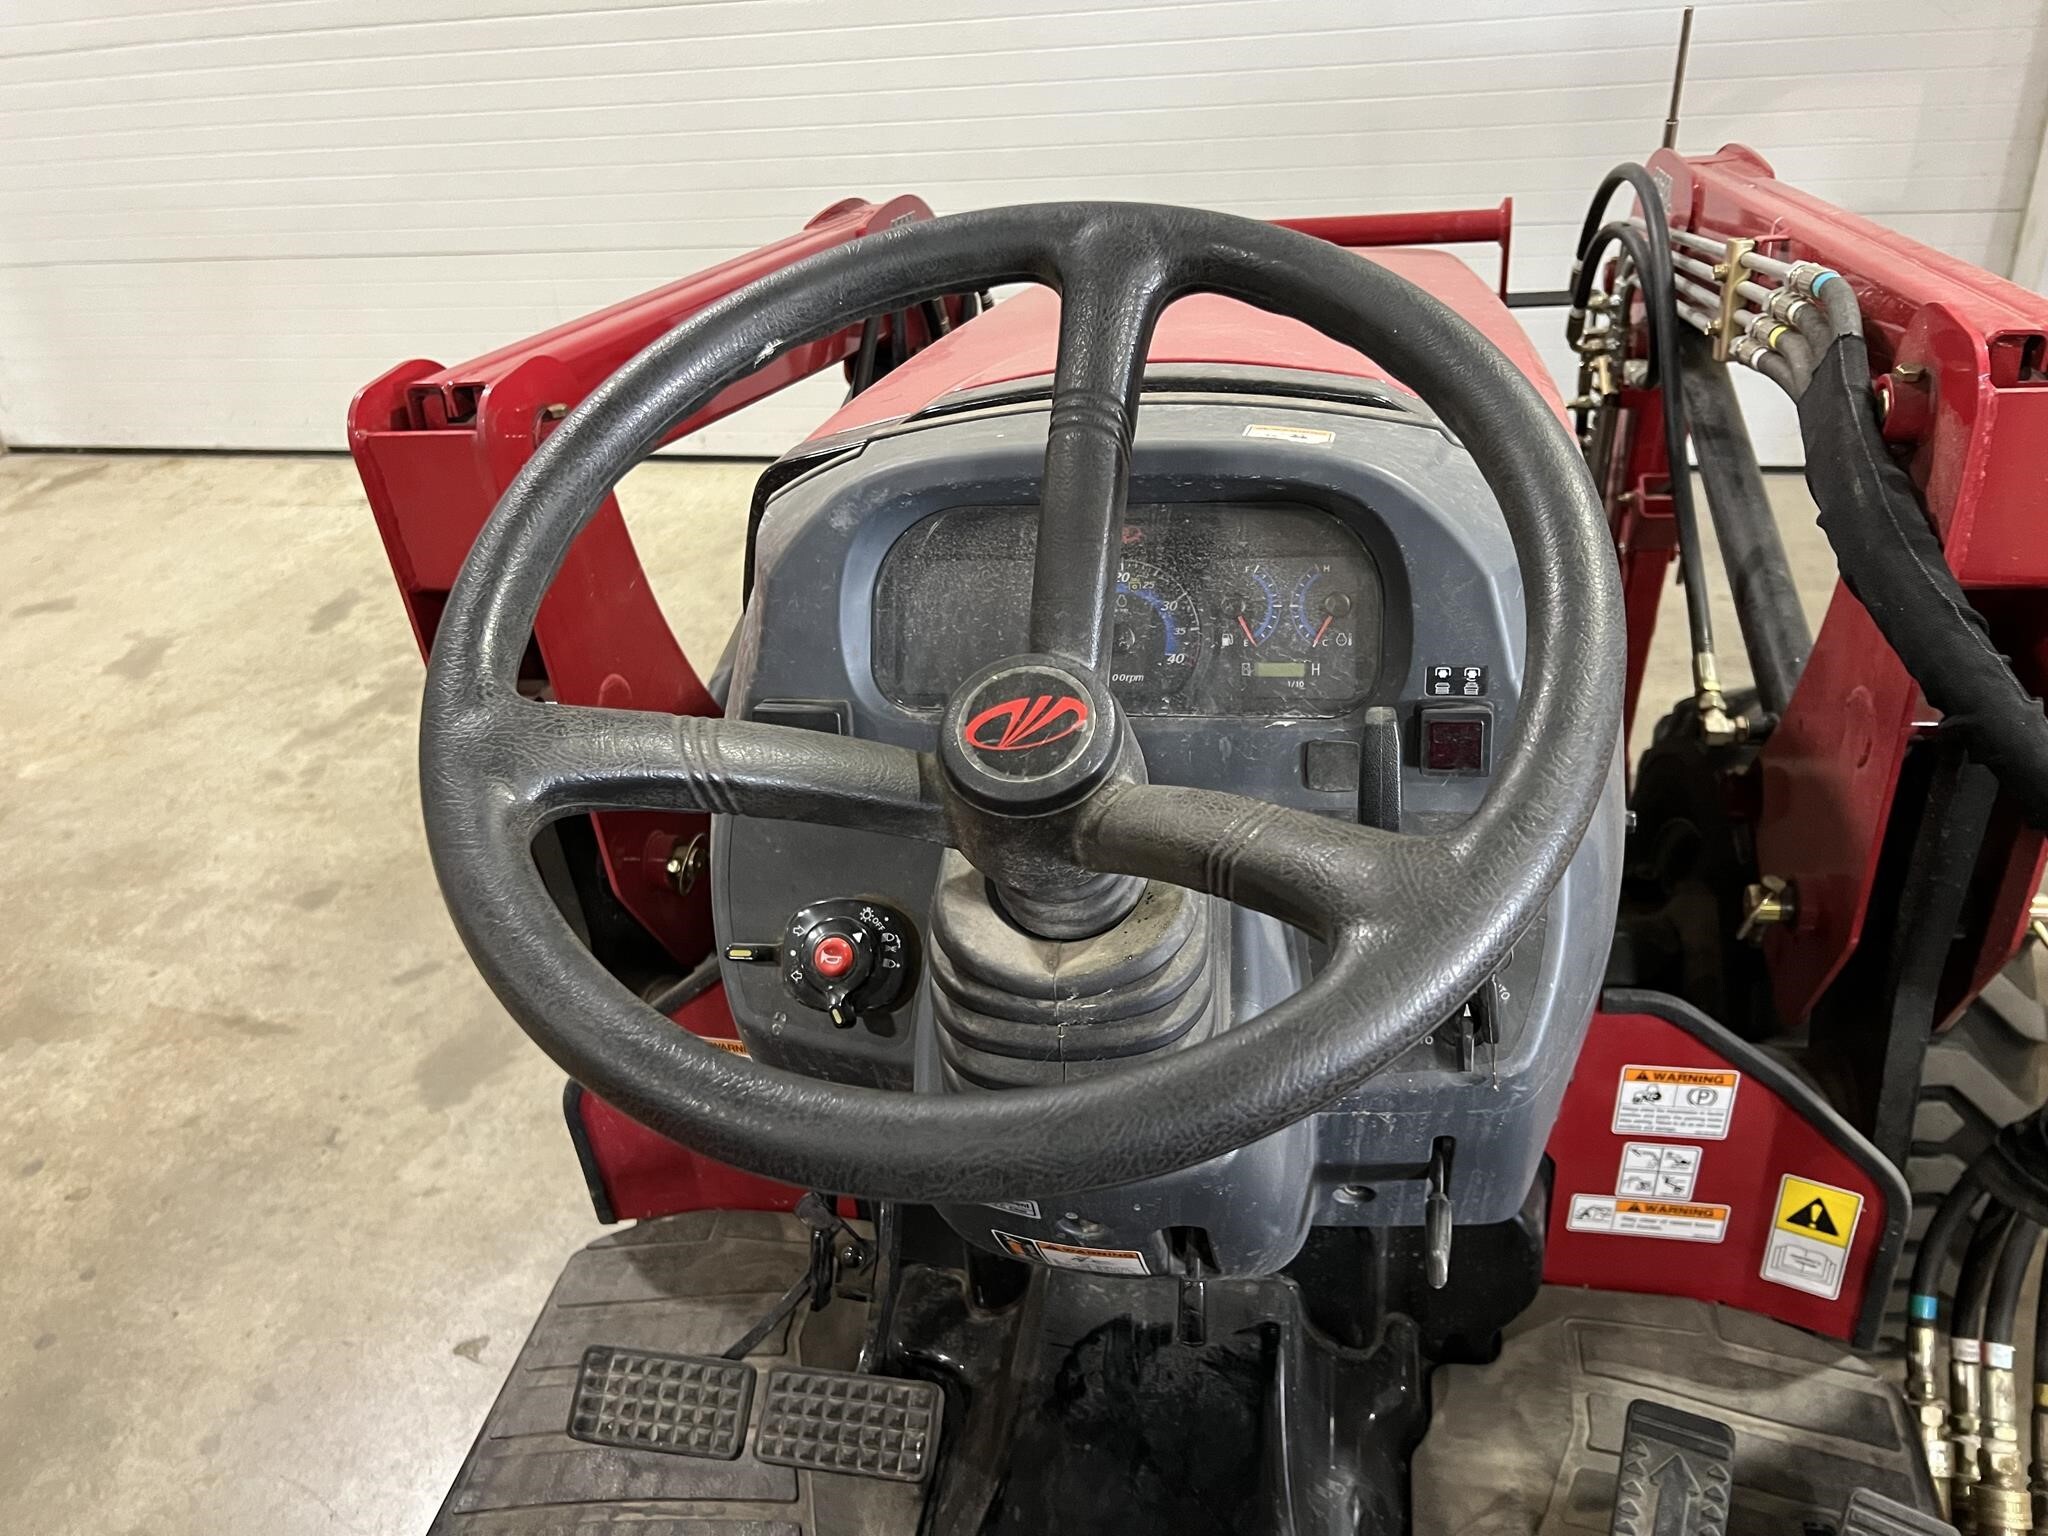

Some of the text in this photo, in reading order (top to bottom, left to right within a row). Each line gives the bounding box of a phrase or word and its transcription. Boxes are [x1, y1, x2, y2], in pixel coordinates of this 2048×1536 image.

[1160, 600, 1178, 612] 30
[1173, 627, 1187, 635] 35
[1166, 653, 1185, 664] 40
[1311, 663, 1320, 675] H
[1112, 673, 1145, 683] 00rpm
[1287, 680, 1305, 688] 1/10
[871, 916, 886, 932] OFF
[1498, 984, 1511, 1001] TO
[709, 1041, 746, 1053] WARNI
[1653, 1071, 1725, 1084] WARNING
[1644, 1203, 1714, 1217] WARNING
